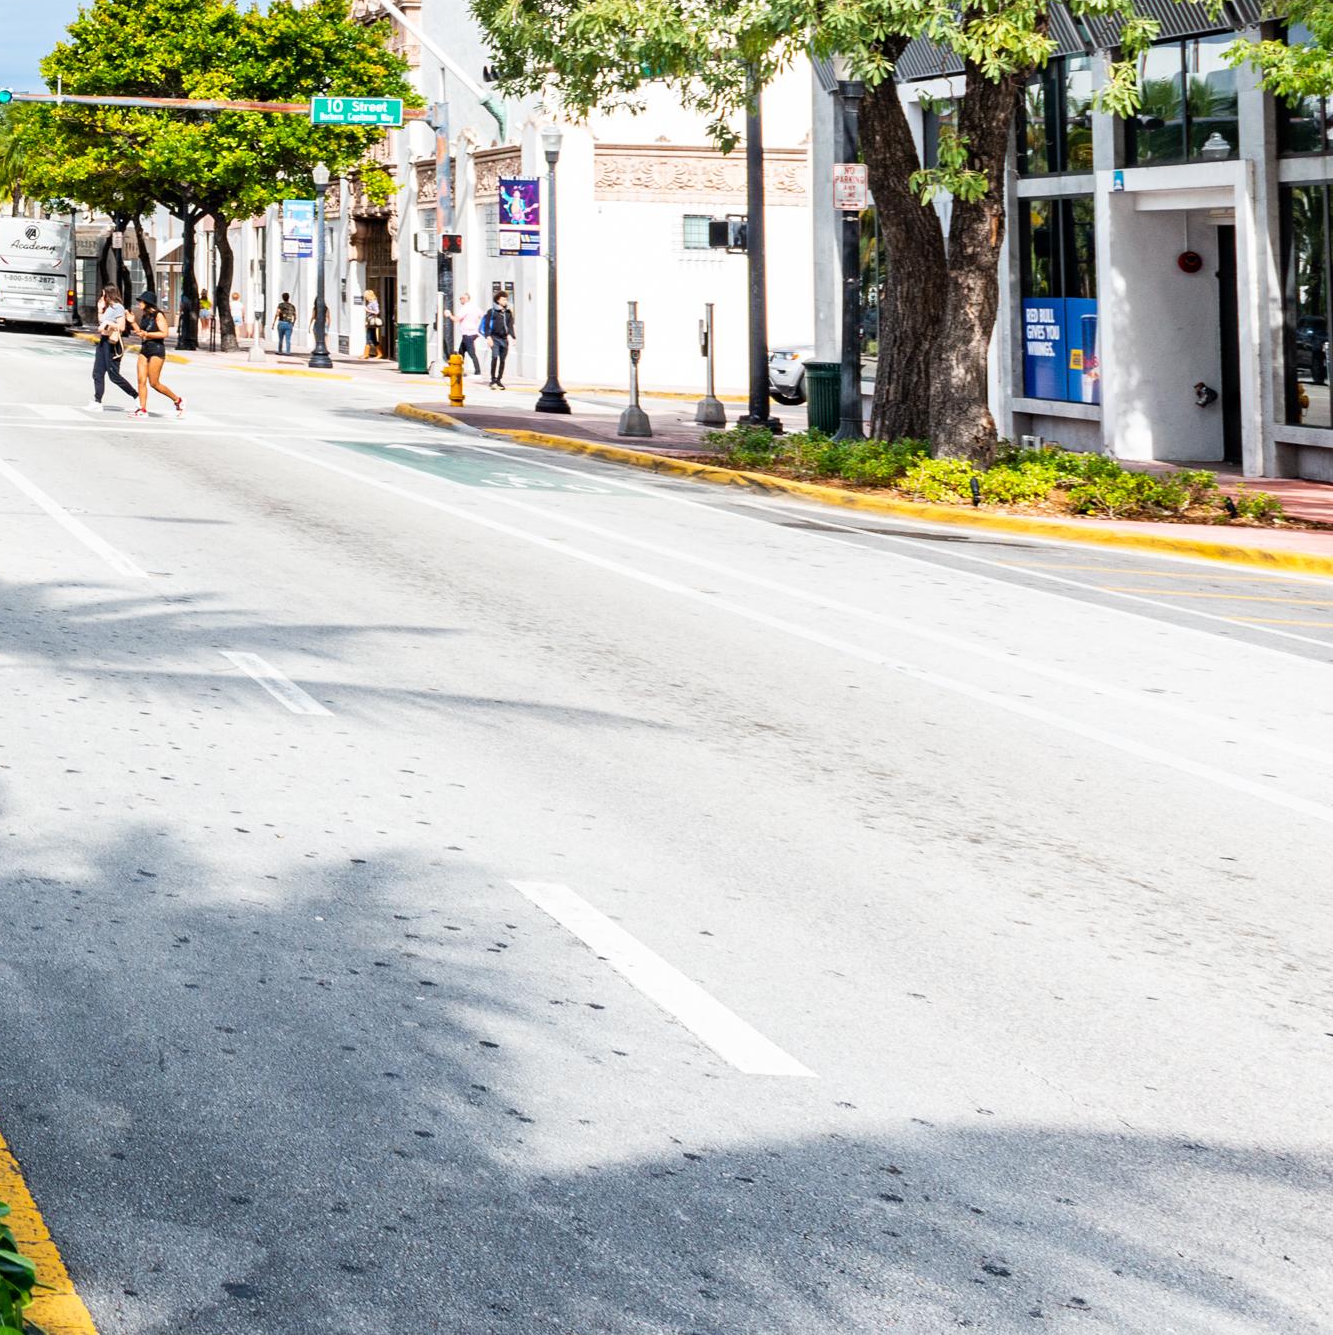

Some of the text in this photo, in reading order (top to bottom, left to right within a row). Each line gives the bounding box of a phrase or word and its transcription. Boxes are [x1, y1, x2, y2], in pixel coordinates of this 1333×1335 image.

[327, 99, 388, 113] 10 Street
[10, 239, 57, 255] Academy
[1026, 308, 1056, 323] RED BULL
[1027, 325, 1061, 341] GIVES YOU
